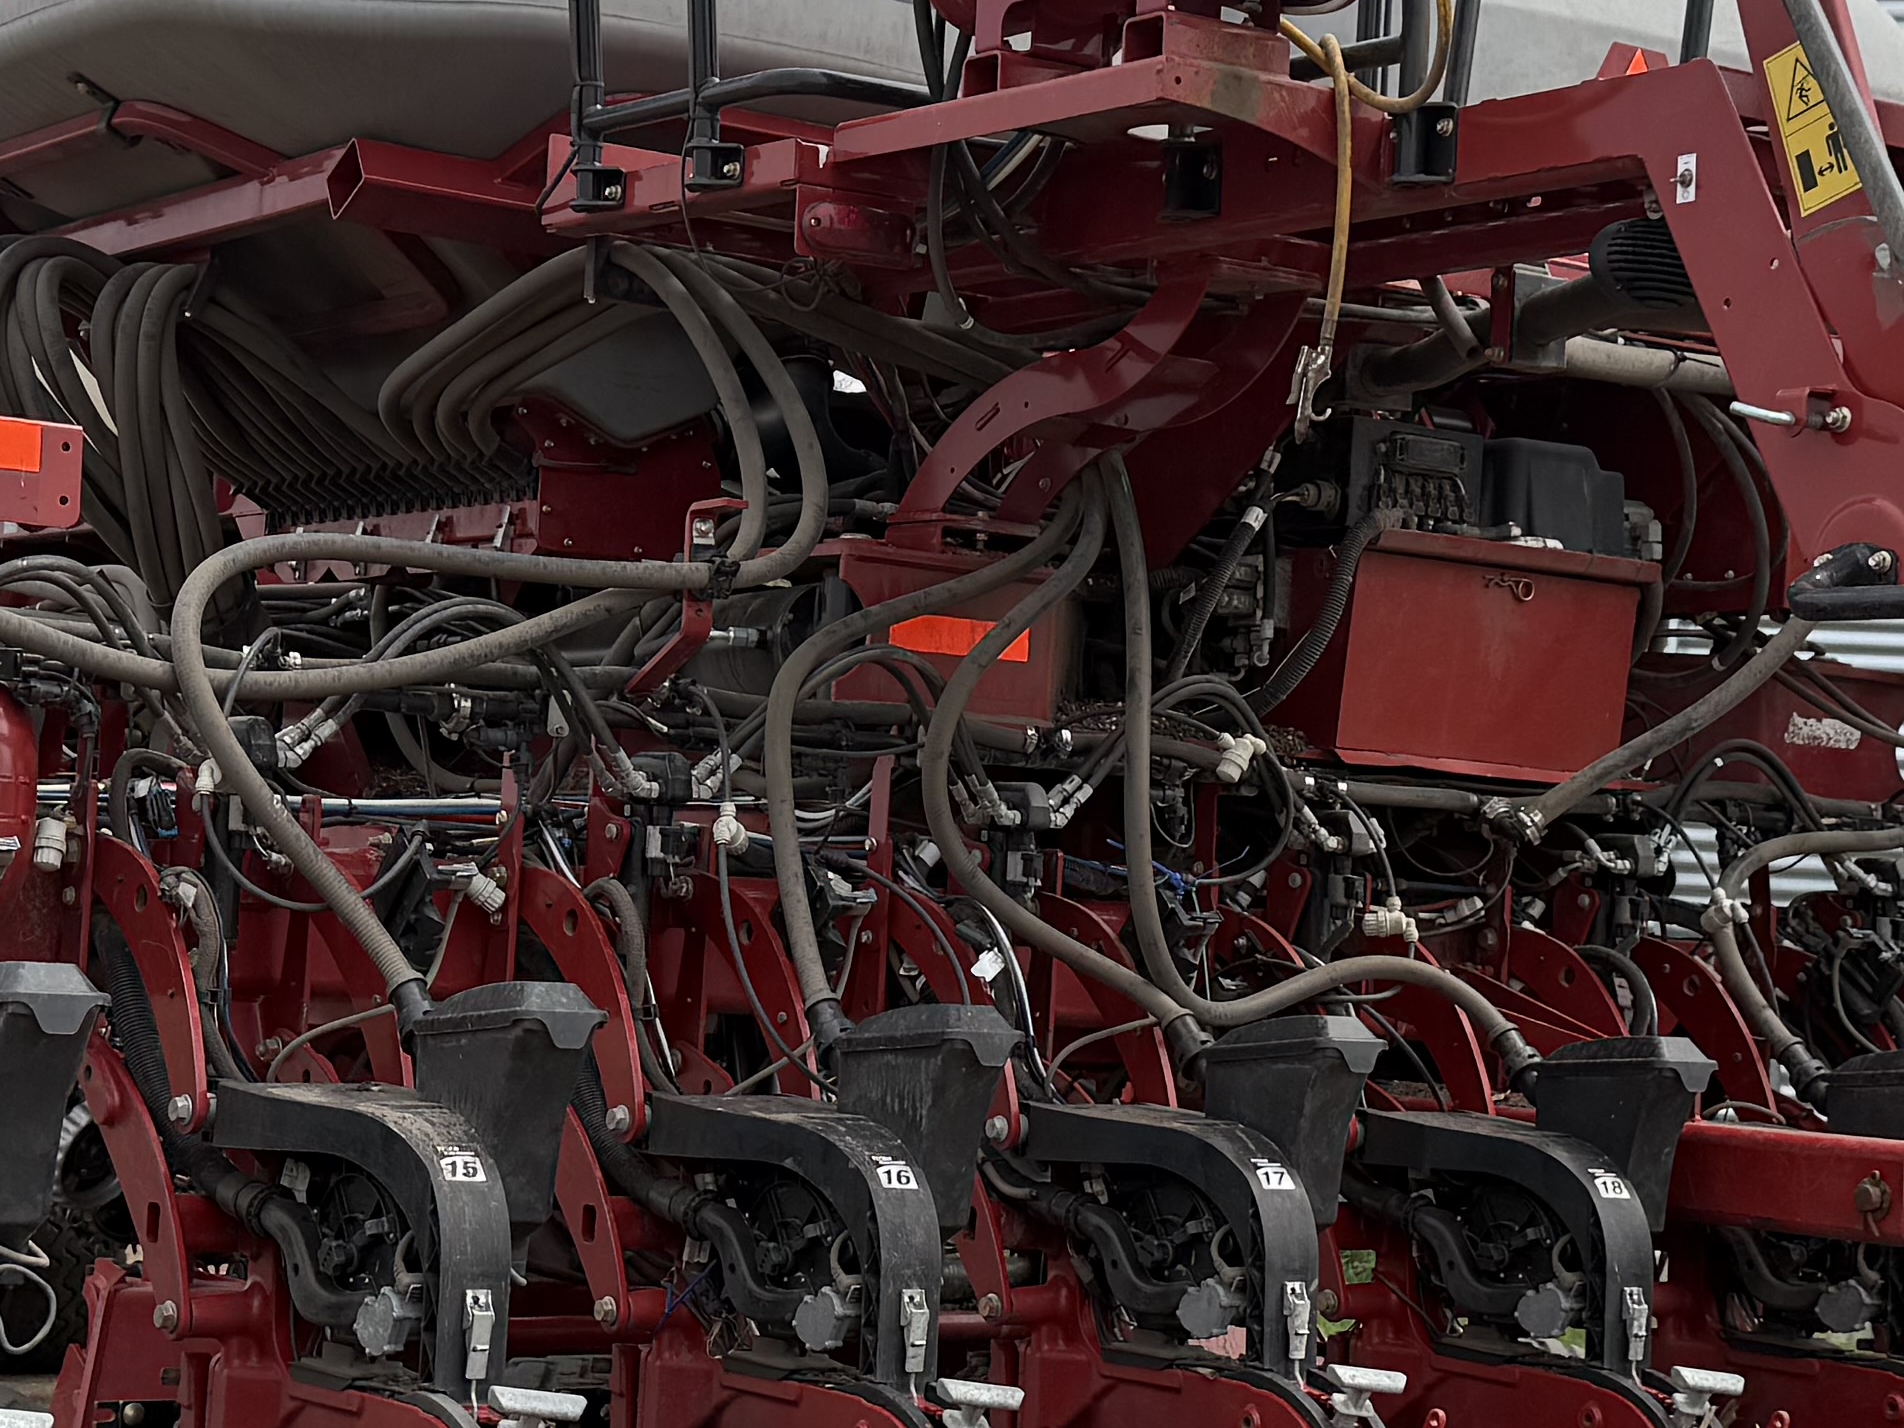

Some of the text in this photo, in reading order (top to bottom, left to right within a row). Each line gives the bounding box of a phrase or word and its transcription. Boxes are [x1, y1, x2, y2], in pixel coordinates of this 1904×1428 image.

[444, 1160, 478, 1178] 15
[882, 1168, 911, 1186] 16
[1261, 1170, 1285, 1186] 17
[1600, 1180, 1623, 1195] 18
